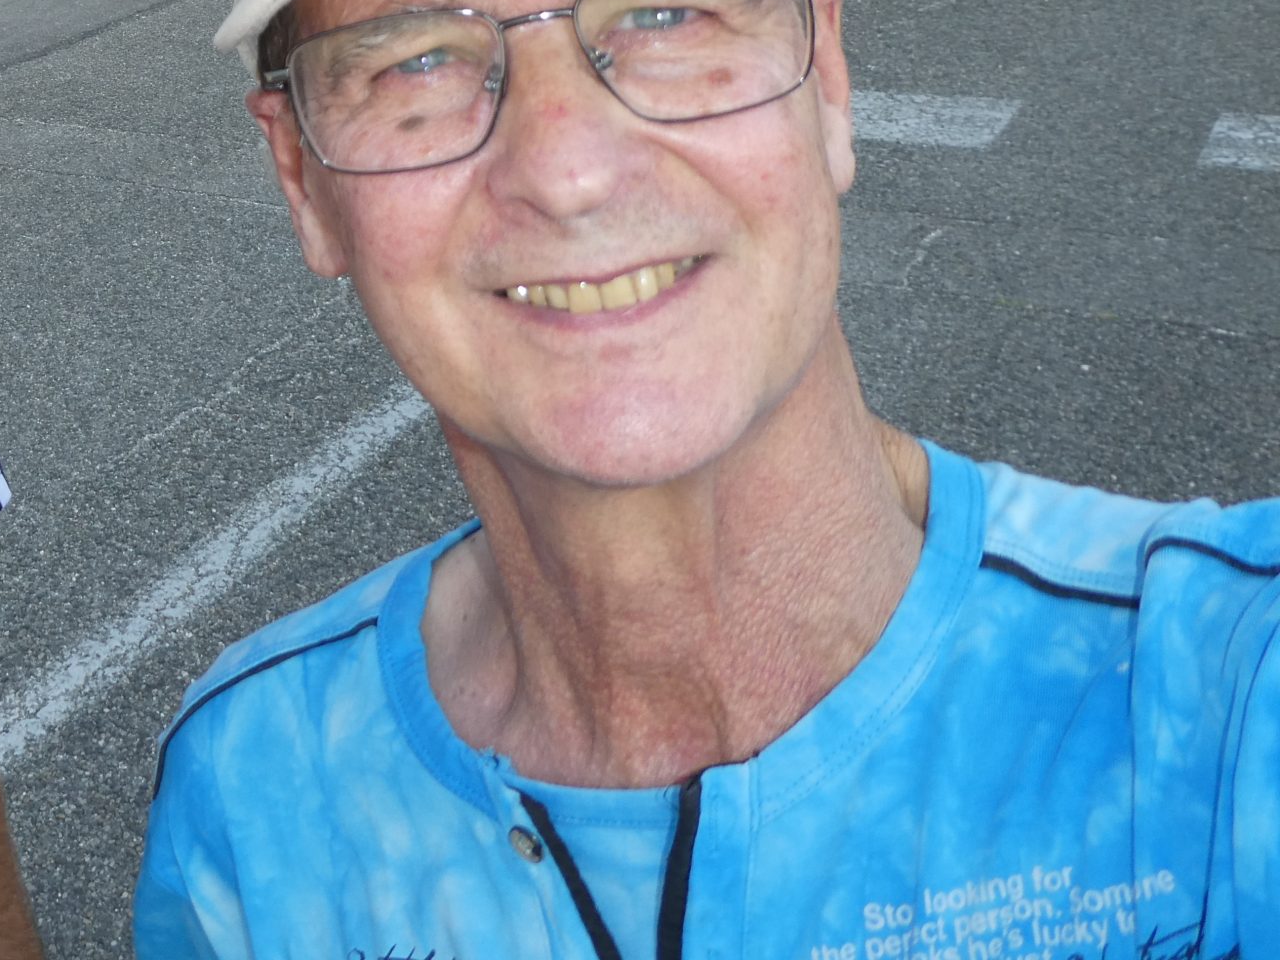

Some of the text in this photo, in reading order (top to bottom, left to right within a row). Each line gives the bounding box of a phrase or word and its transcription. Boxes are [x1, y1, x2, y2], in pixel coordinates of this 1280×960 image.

[863, 865, 1073, 931] Sto looking for
[865, 916, 948, 960] perct
[953, 897, 1062, 946] person.
[1032, 916, 1109, 950] lucky
